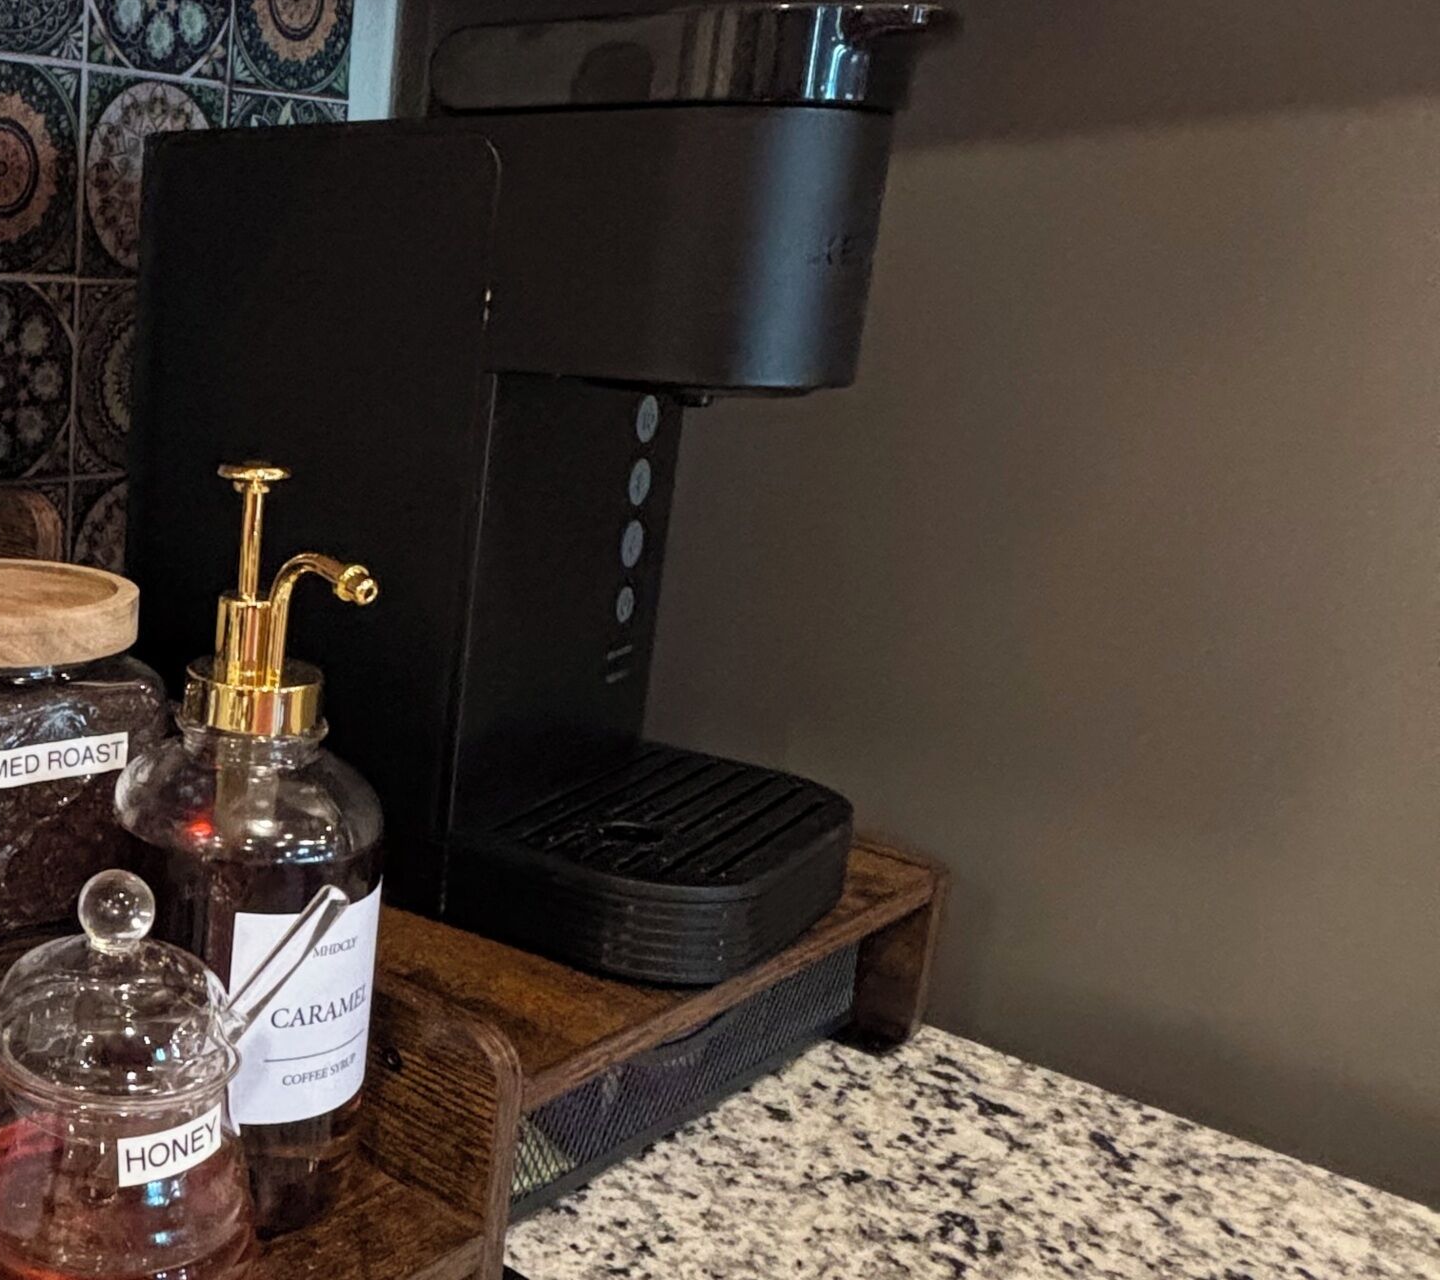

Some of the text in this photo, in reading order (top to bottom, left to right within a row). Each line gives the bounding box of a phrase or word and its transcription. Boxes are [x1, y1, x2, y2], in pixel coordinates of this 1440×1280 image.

[48, 740, 125, 771] ROAST
[270, 983, 367, 1030] CARAMEL
[281, 1051, 357, 1087] COFFEE SYRUP
[125, 1113, 219, 1173] HONEY
